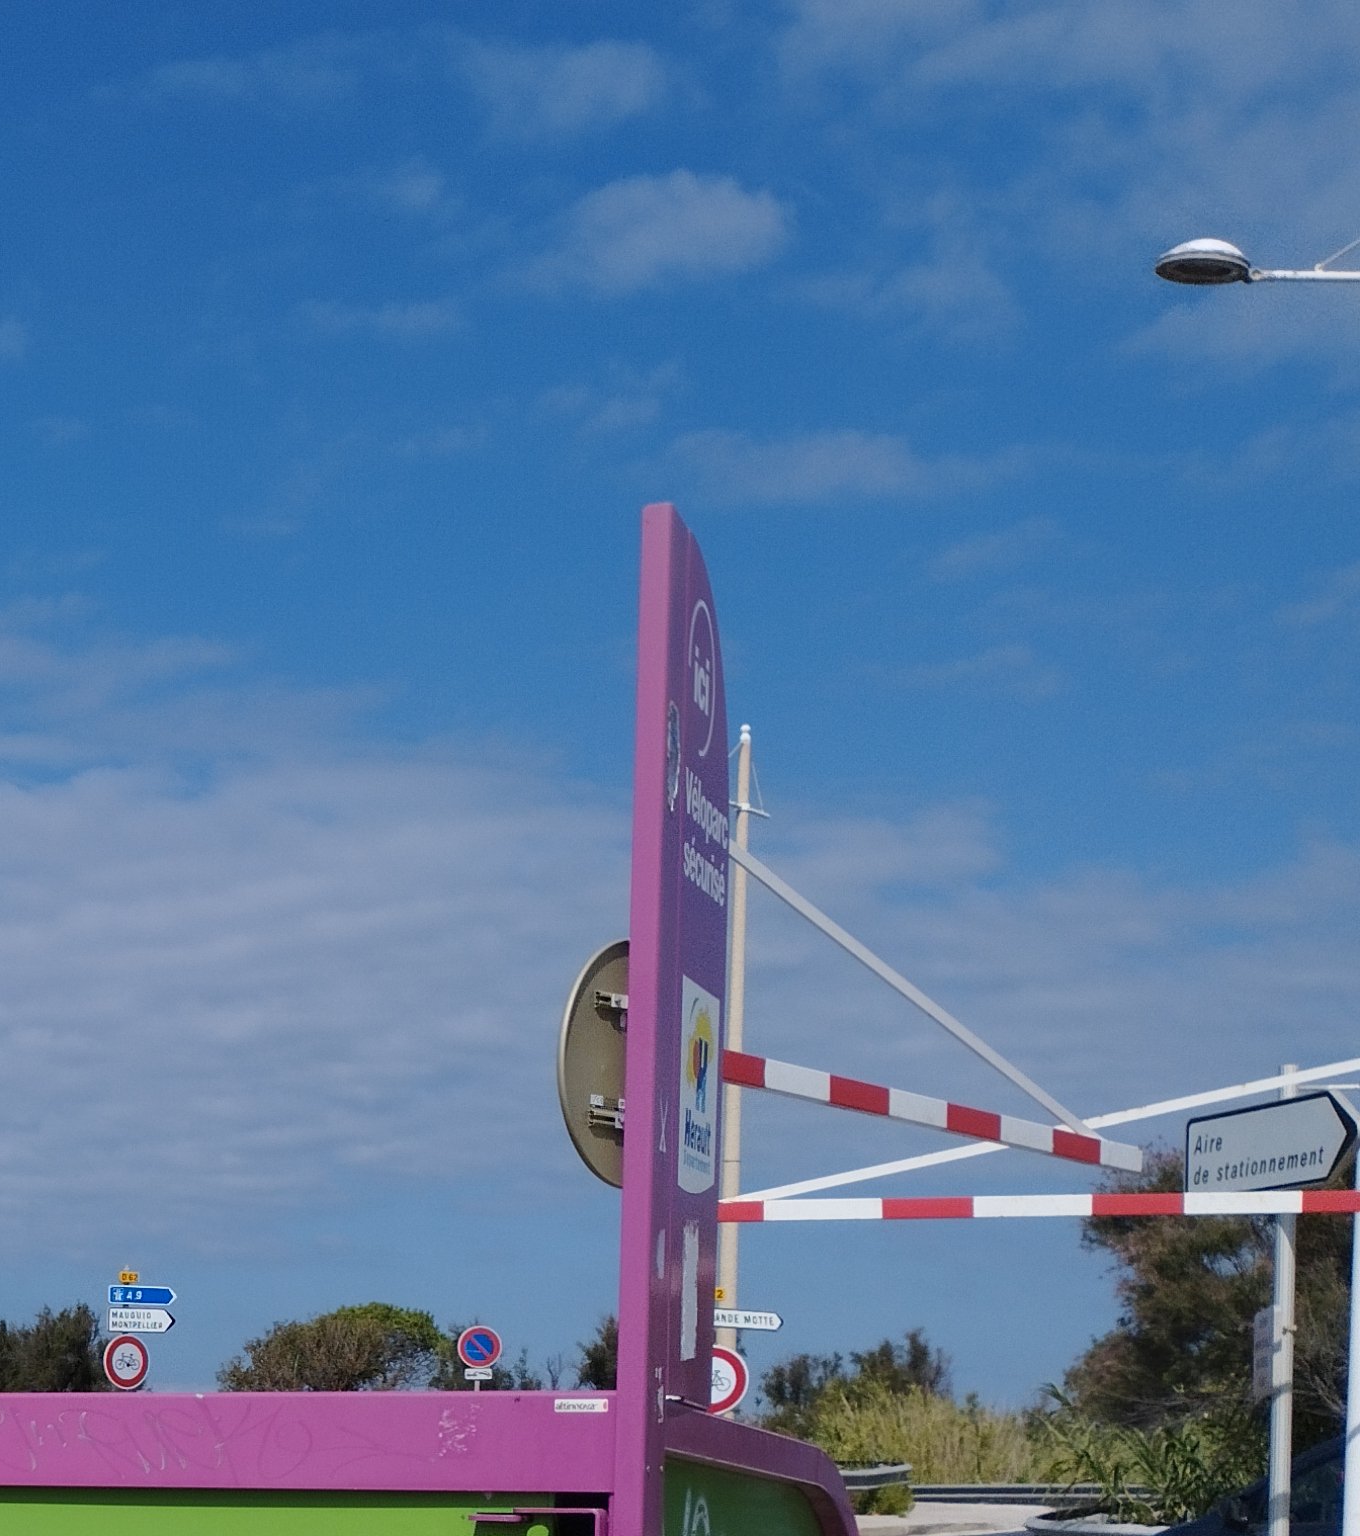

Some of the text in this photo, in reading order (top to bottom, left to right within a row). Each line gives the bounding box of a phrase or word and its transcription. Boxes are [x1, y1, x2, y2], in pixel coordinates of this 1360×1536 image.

[686, 766, 728, 850] Véloparc
[683, 837, 726, 907] sécurisé
[1194, 1134, 1223, 1155] Aire
[1194, 1146, 1324, 1185] de stationnement
[112, 1321, 163, 1330] MONTPELLIER
[743, 1315, 774, 1326] MOTTE
